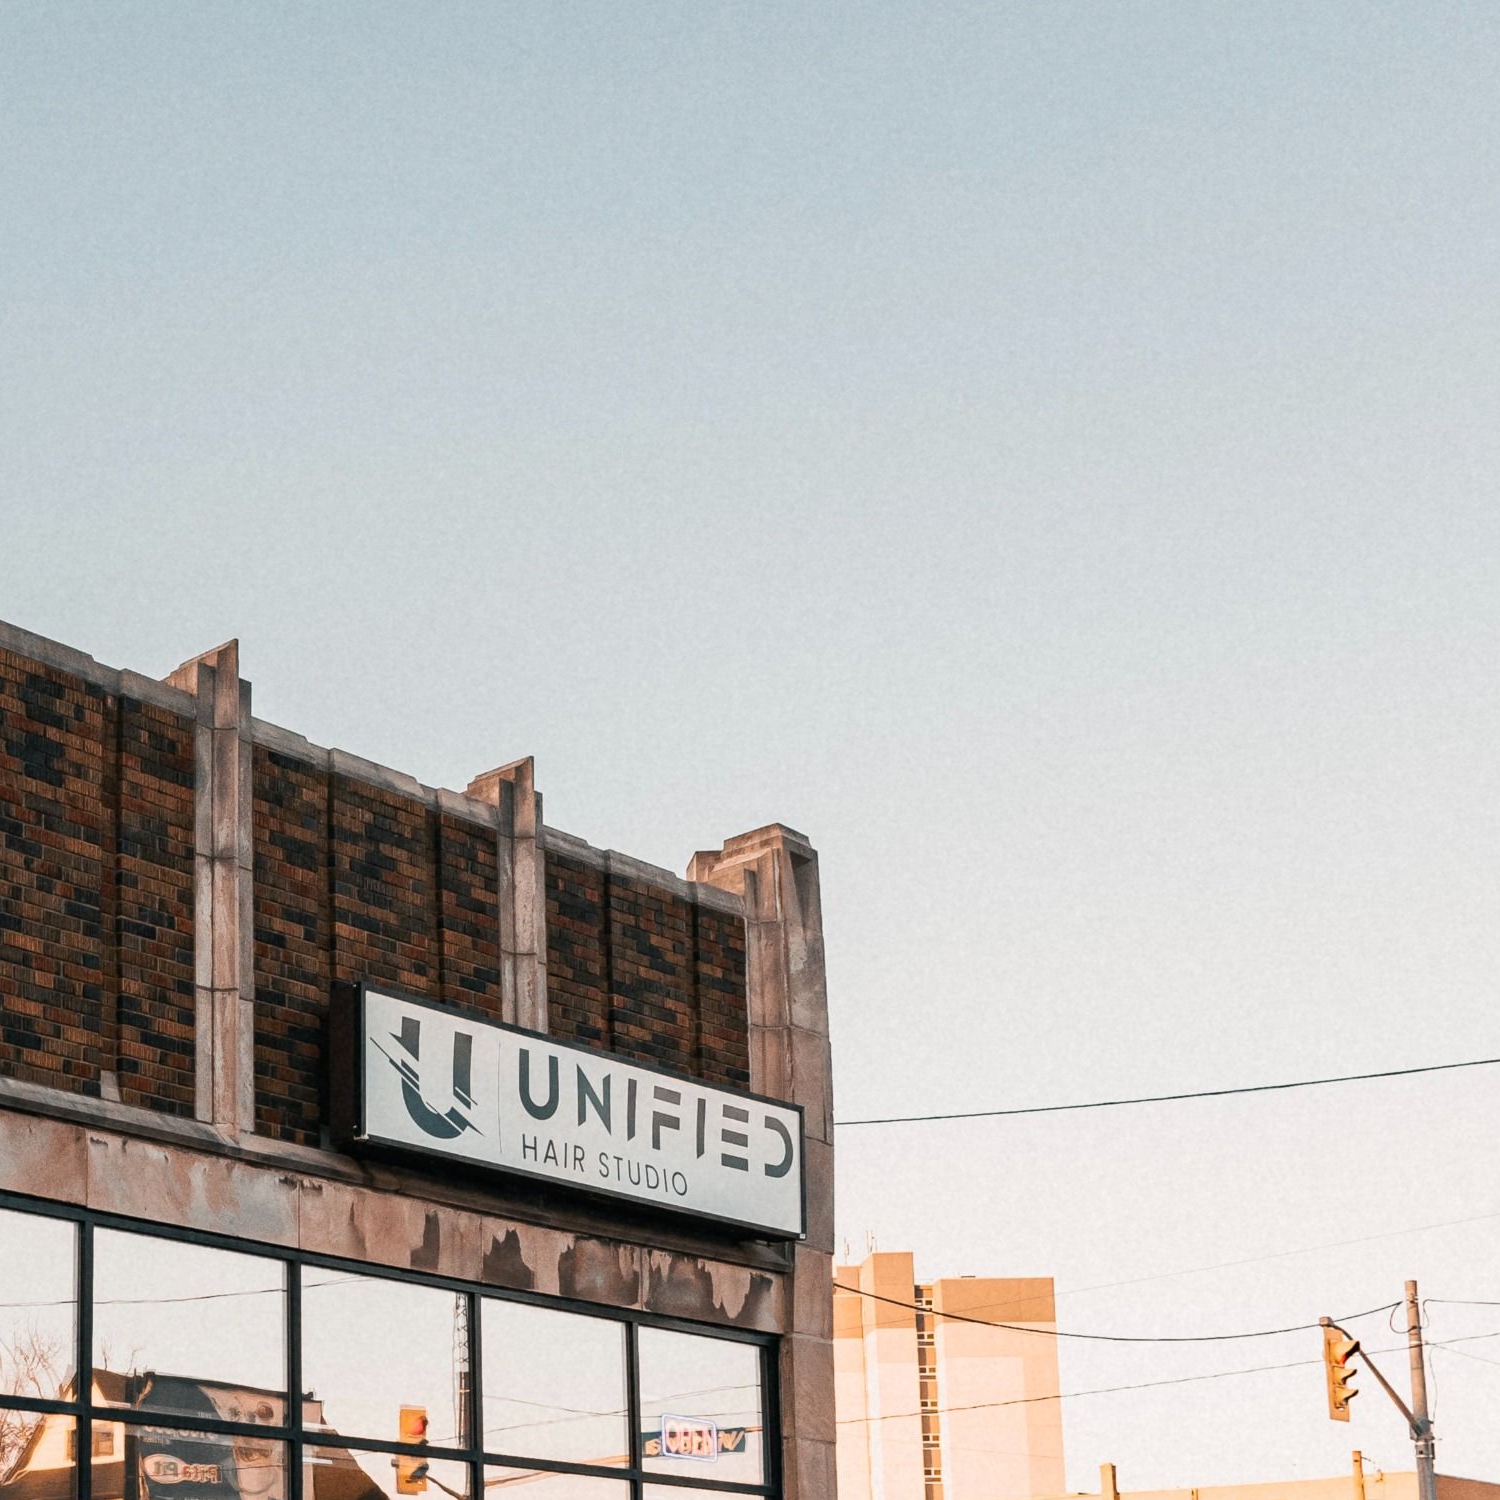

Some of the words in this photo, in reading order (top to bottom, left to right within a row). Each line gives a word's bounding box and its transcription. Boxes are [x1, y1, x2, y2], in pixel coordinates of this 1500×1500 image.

[519, 1048, 793, 1179] UNIFIED
[522, 1133, 585, 1173] HAIR
[598, 1151, 688, 1197] STUDIO
